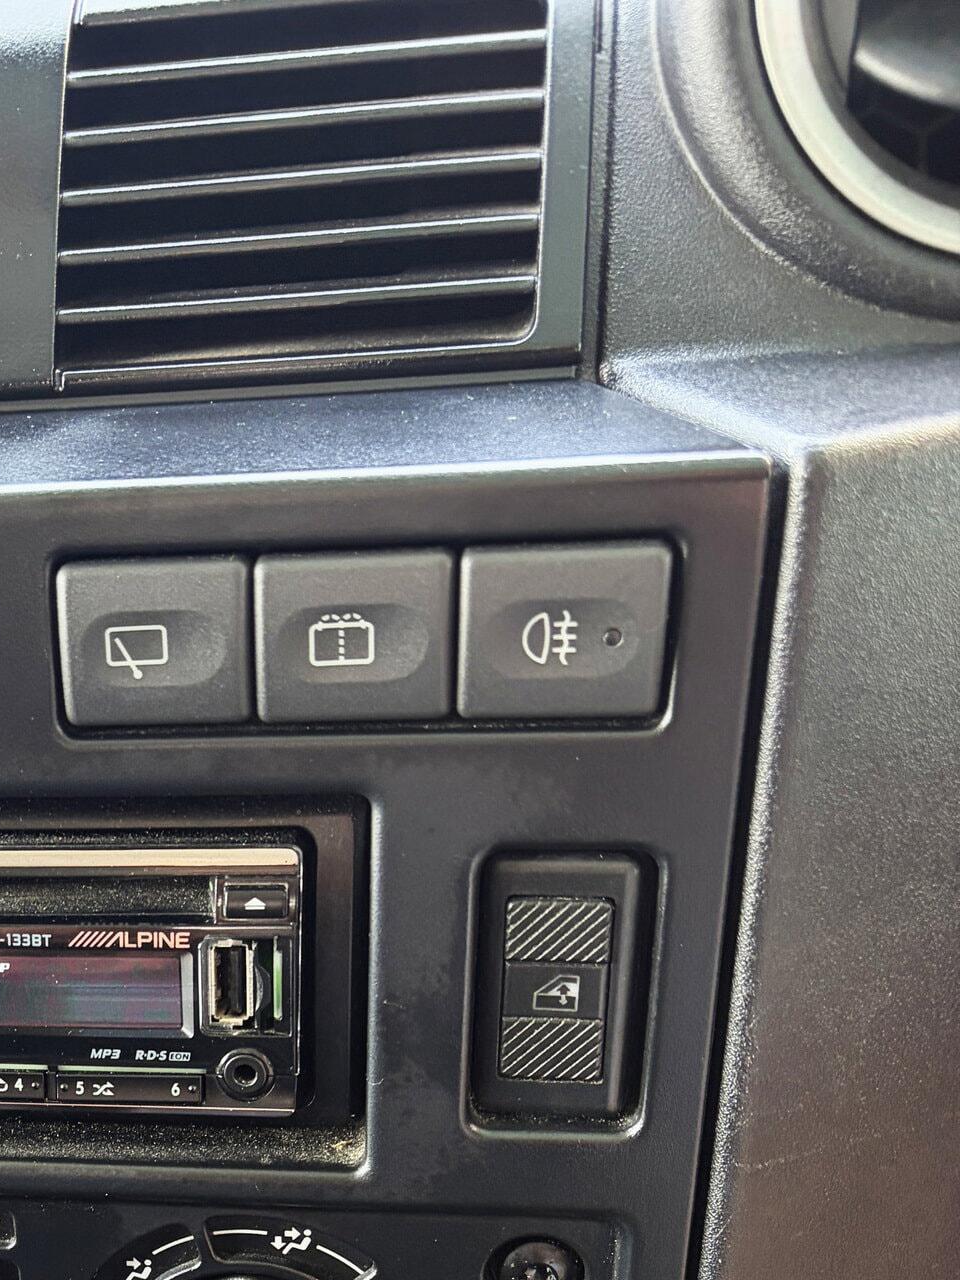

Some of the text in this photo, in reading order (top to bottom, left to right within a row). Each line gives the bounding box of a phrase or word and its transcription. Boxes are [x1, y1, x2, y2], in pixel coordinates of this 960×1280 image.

[104, 931, 191, 949] ALPINE
[90, 1048, 121, 1060] MP3
[14, 1078, 24, 1092] 4
[75, 1081, 85, 1096] 5
[170, 1082, 181, 1097] 6
